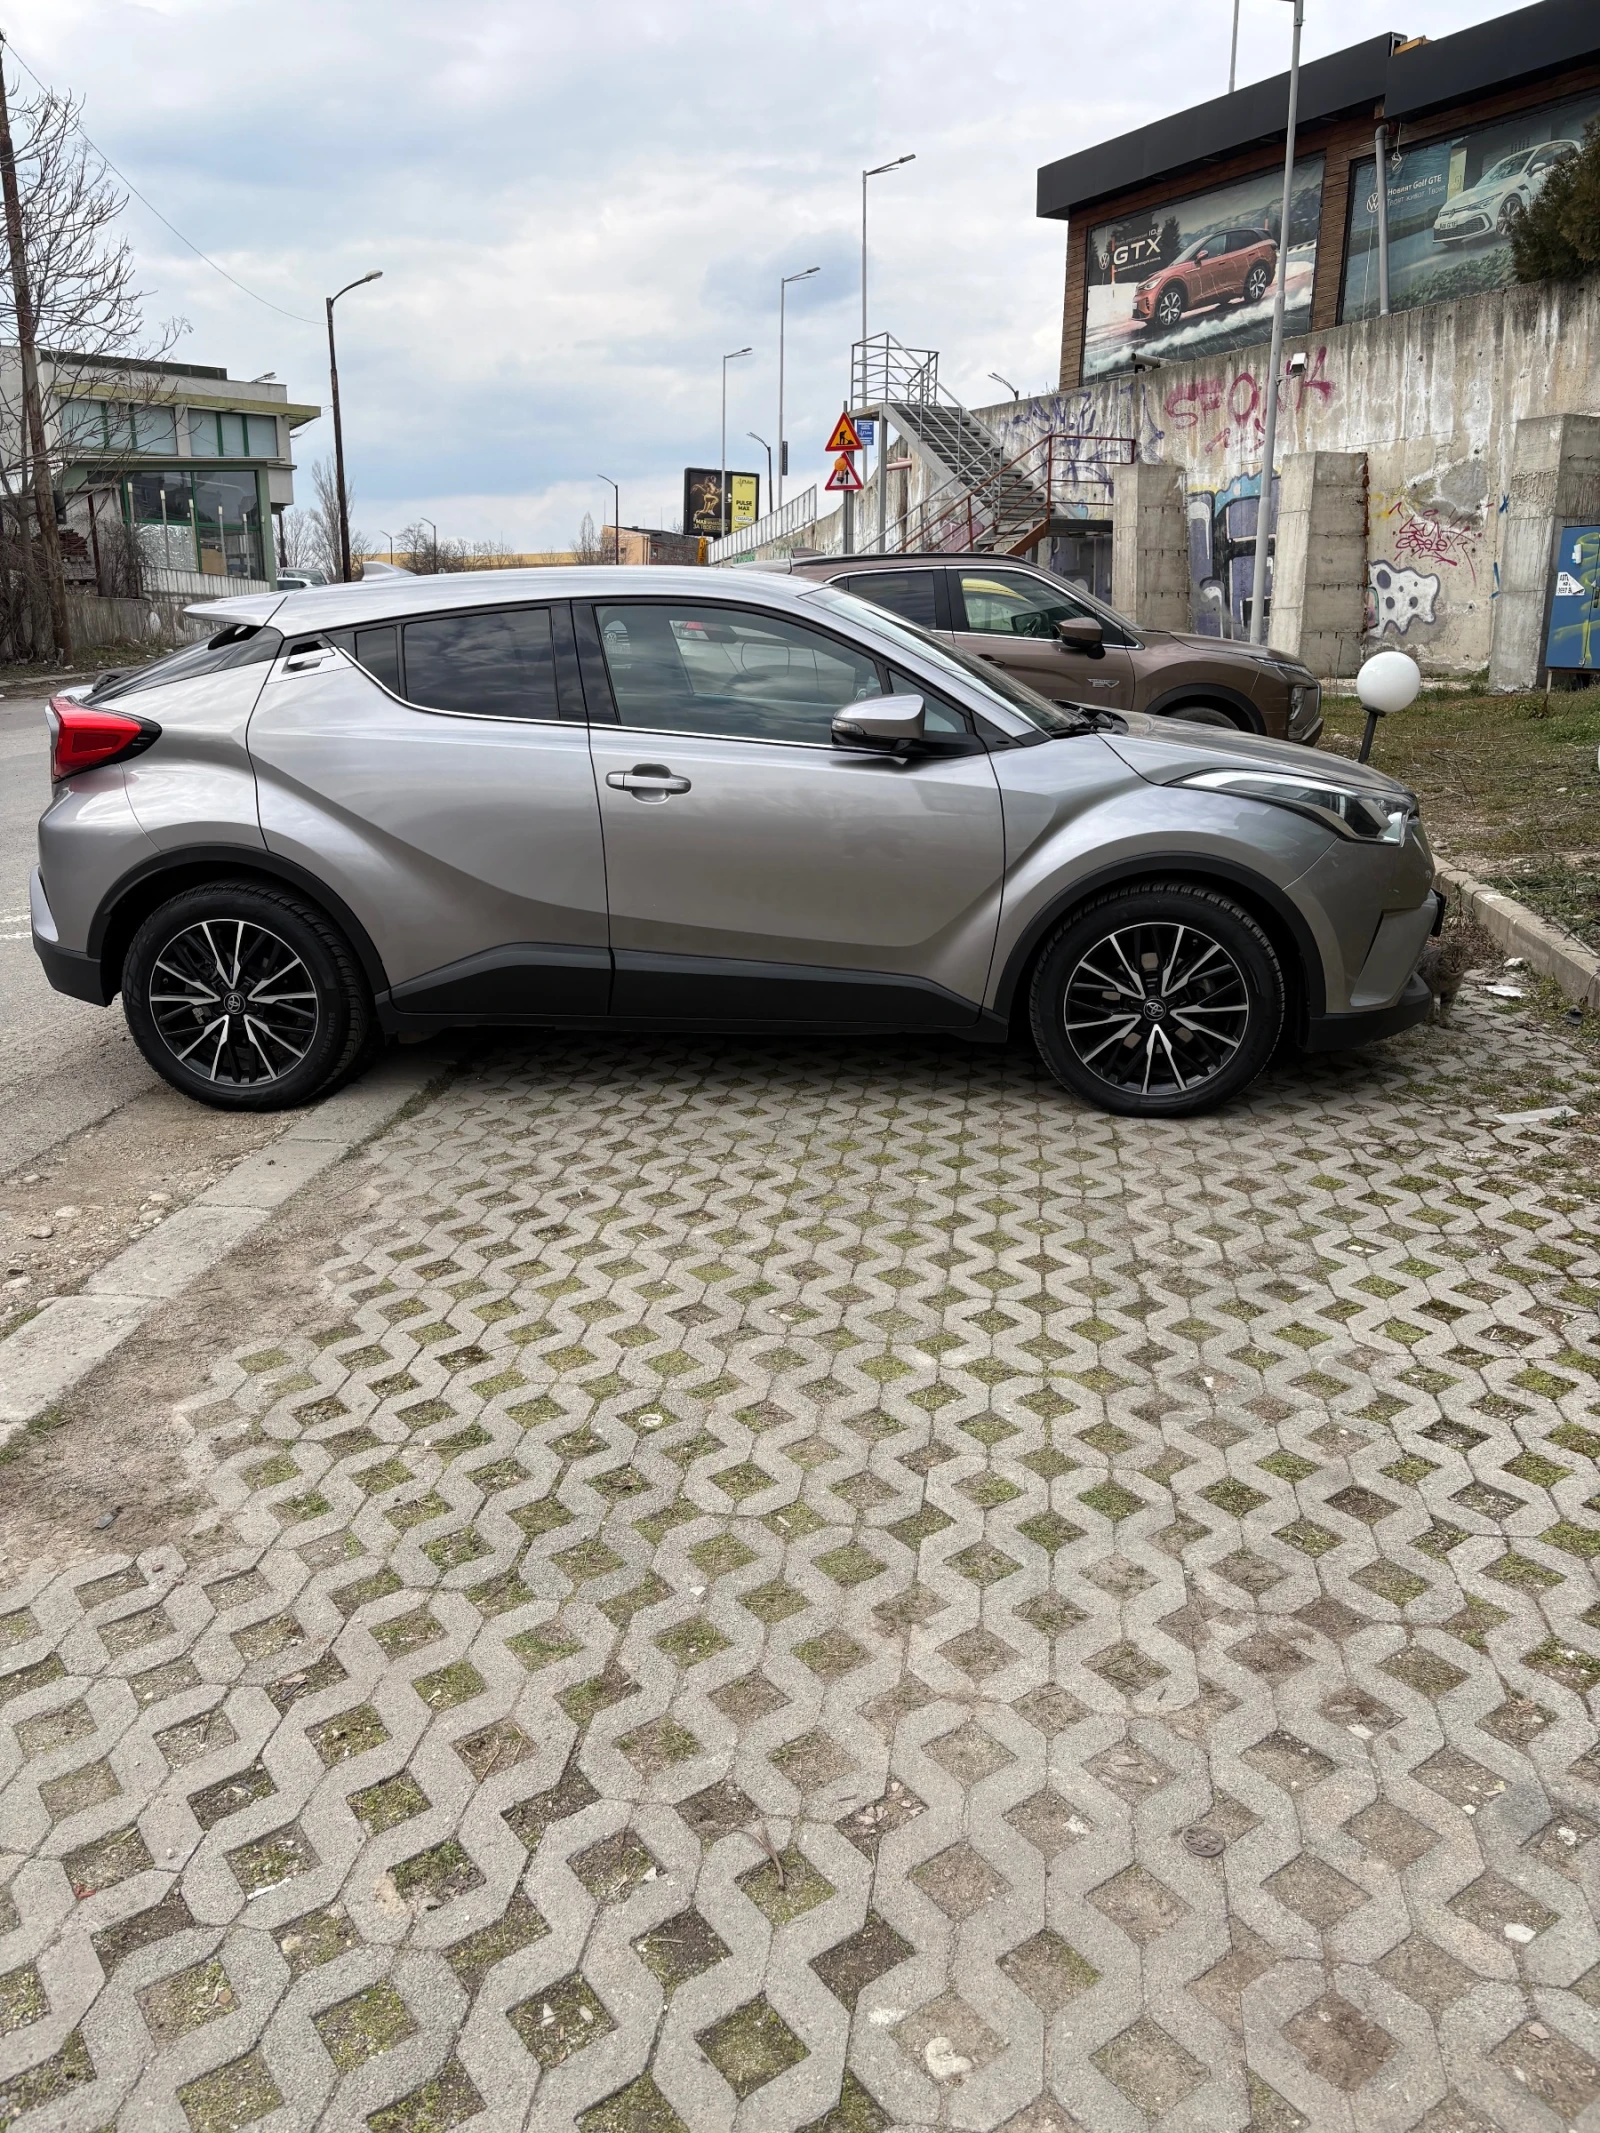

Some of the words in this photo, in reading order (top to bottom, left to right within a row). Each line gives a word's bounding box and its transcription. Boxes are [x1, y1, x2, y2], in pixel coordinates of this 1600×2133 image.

[1387, 184, 1412, 196] Новият
[1413, 179, 1427, 190] Golf
[1428, 173, 1442, 185] GTE
[1113, 235, 1161, 265] GTX
